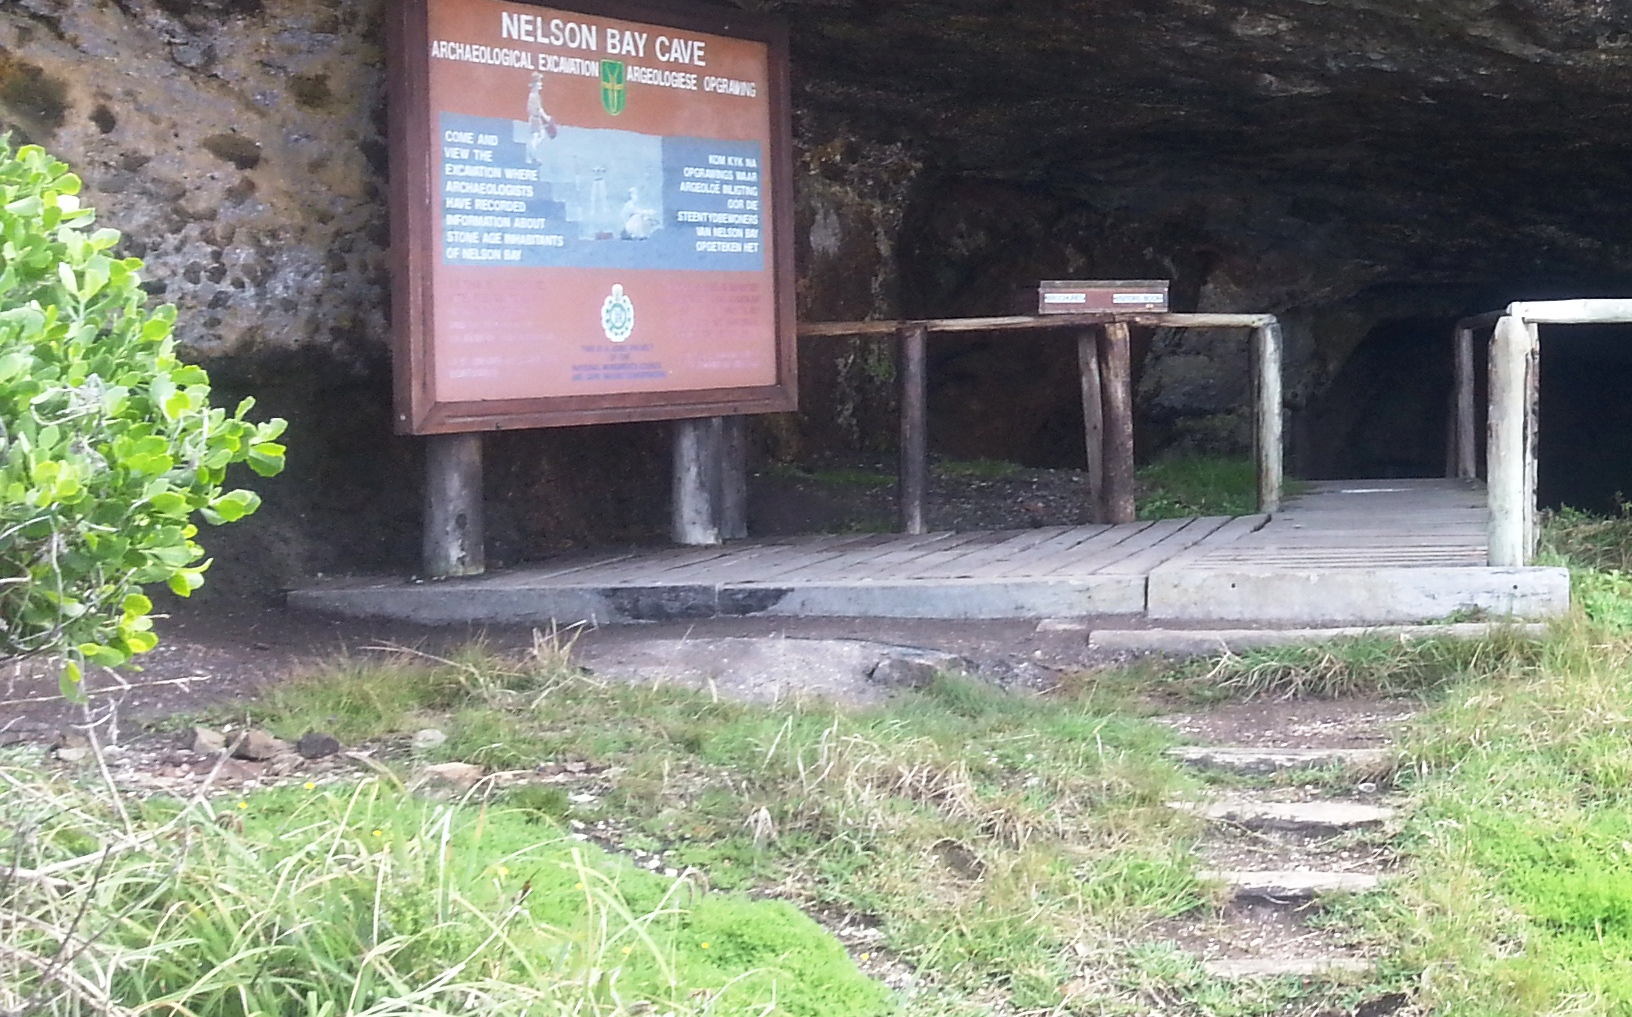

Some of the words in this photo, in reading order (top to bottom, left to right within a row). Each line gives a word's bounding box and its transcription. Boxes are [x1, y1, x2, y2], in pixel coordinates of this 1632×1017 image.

[501, 11, 597, 51] NELSON
[606, 28, 648, 58] BAY
[655, 35, 706, 67] CAVE
[431, 40, 535, 70] ARCHAEOLOGICAL
[538, 53, 599, 77] EXCAVATION
[626, 65, 698, 91] ARGEOLOGIESE
[703, 75, 757, 98] OPGRAWING
[445, 130, 474, 144] COME
[477, 134, 498, 146] AND
[444, 147, 470, 160] VIEW
[473, 149, 493, 163] THE
[445, 163, 502, 179] EXCAVATION
[504, 168, 538, 182] WHERE
[445, 180, 534, 198] ARCHAEOLOGISTS
[446, 197, 472, 210] HAVE
[474, 198, 526, 213] RECORDED
[446, 214, 511, 228] INFORMATION
[513, 217, 546, 229] ABOUT
[446, 230, 480, 244] STONE
[482, 232, 503, 244] AGE
[713, 226, 743, 238] NELSON
[446, 247, 460, 259] OF
[462, 247, 501, 260] NELSON
[503, 249, 522, 261] BAY
